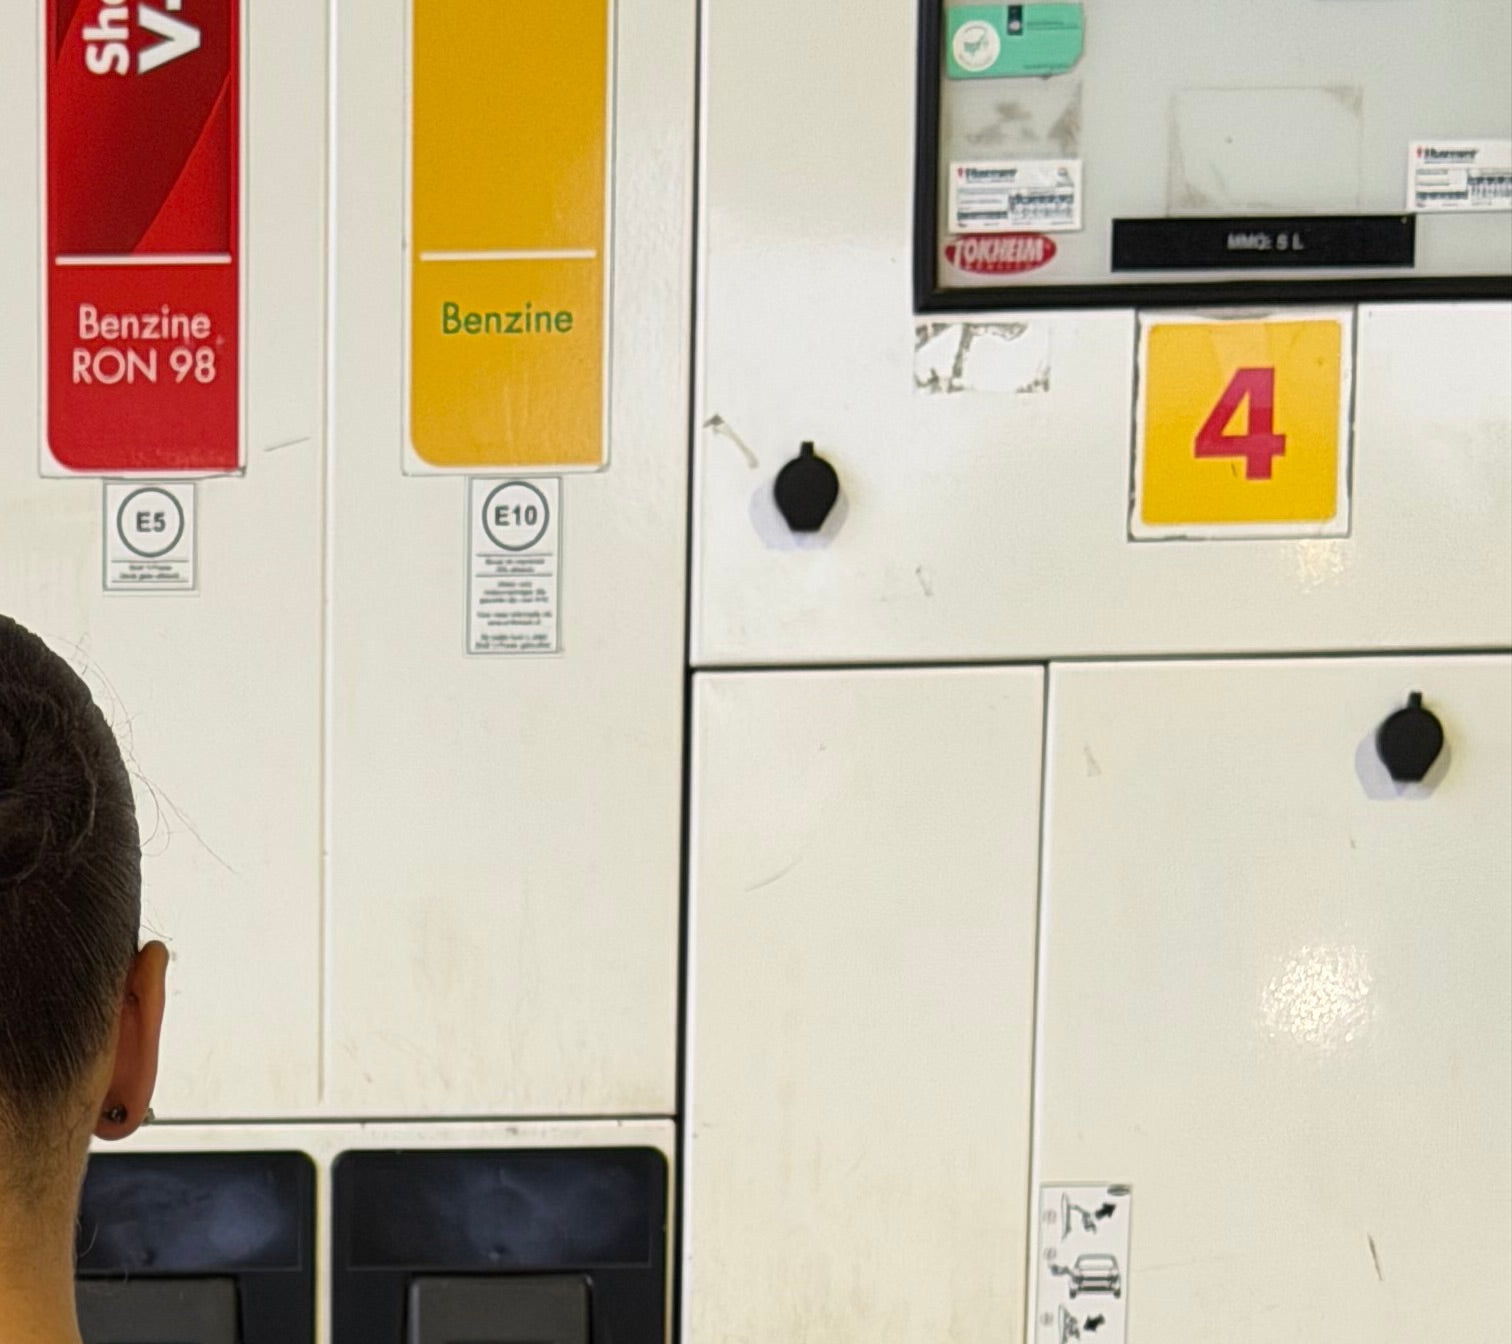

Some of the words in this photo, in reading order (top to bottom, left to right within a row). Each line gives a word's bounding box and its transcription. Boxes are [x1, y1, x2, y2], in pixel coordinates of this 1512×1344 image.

[82, 0, 130, 76] Sh
[1292, 232, 1305, 251] L
[79, 303, 211, 340] Benzine
[442, 301, 574, 335] Benzine
[73, 347, 158, 385] RON
[169, 347, 216, 384] 98
[1194, 367, 1286, 481] 4
[136, 511, 166, 533] E5
[494, 505, 538, 527] E10
